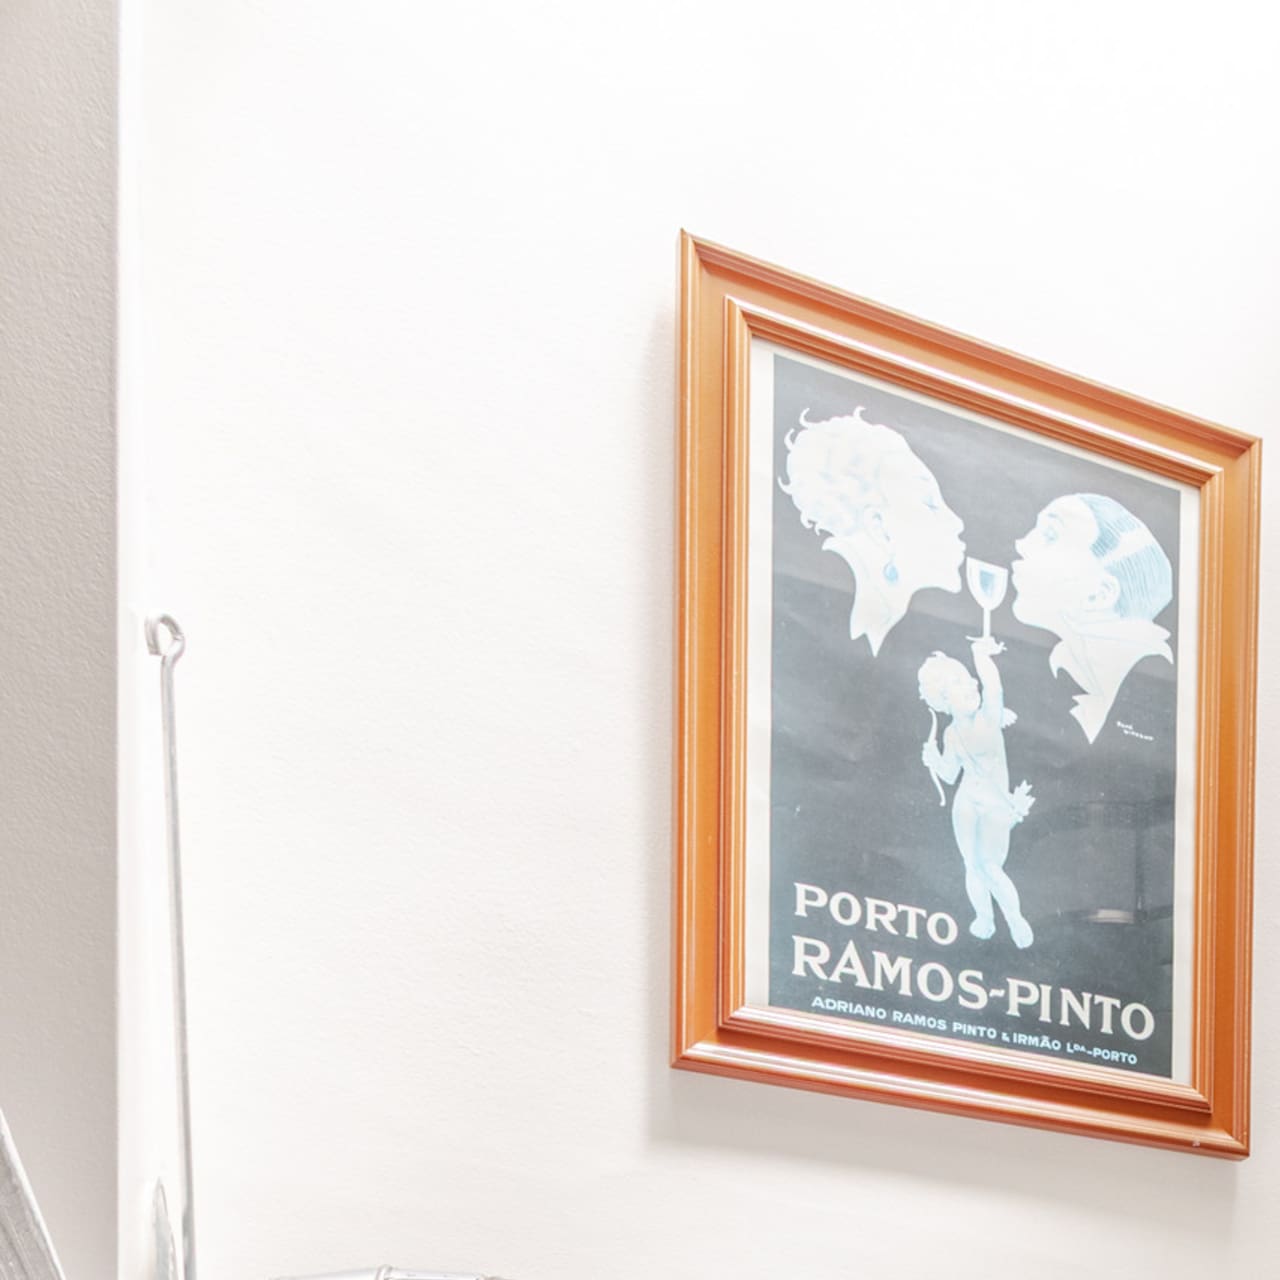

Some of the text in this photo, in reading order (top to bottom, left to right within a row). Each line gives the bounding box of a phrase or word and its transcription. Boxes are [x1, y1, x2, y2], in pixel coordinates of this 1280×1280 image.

[793, 882, 958, 945] PORTO
[791, 935, 1155, 1041] RAMOS-PINTO
[811, 996, 887, 1020] ADRIANO
[892, 1010, 947, 1031] RAMOS
[952, 1022, 997, 1039] PINTO
[1001, 1031, 1010, 1043] &
[1013, 1031, 1062, 1051] IRMÃO
